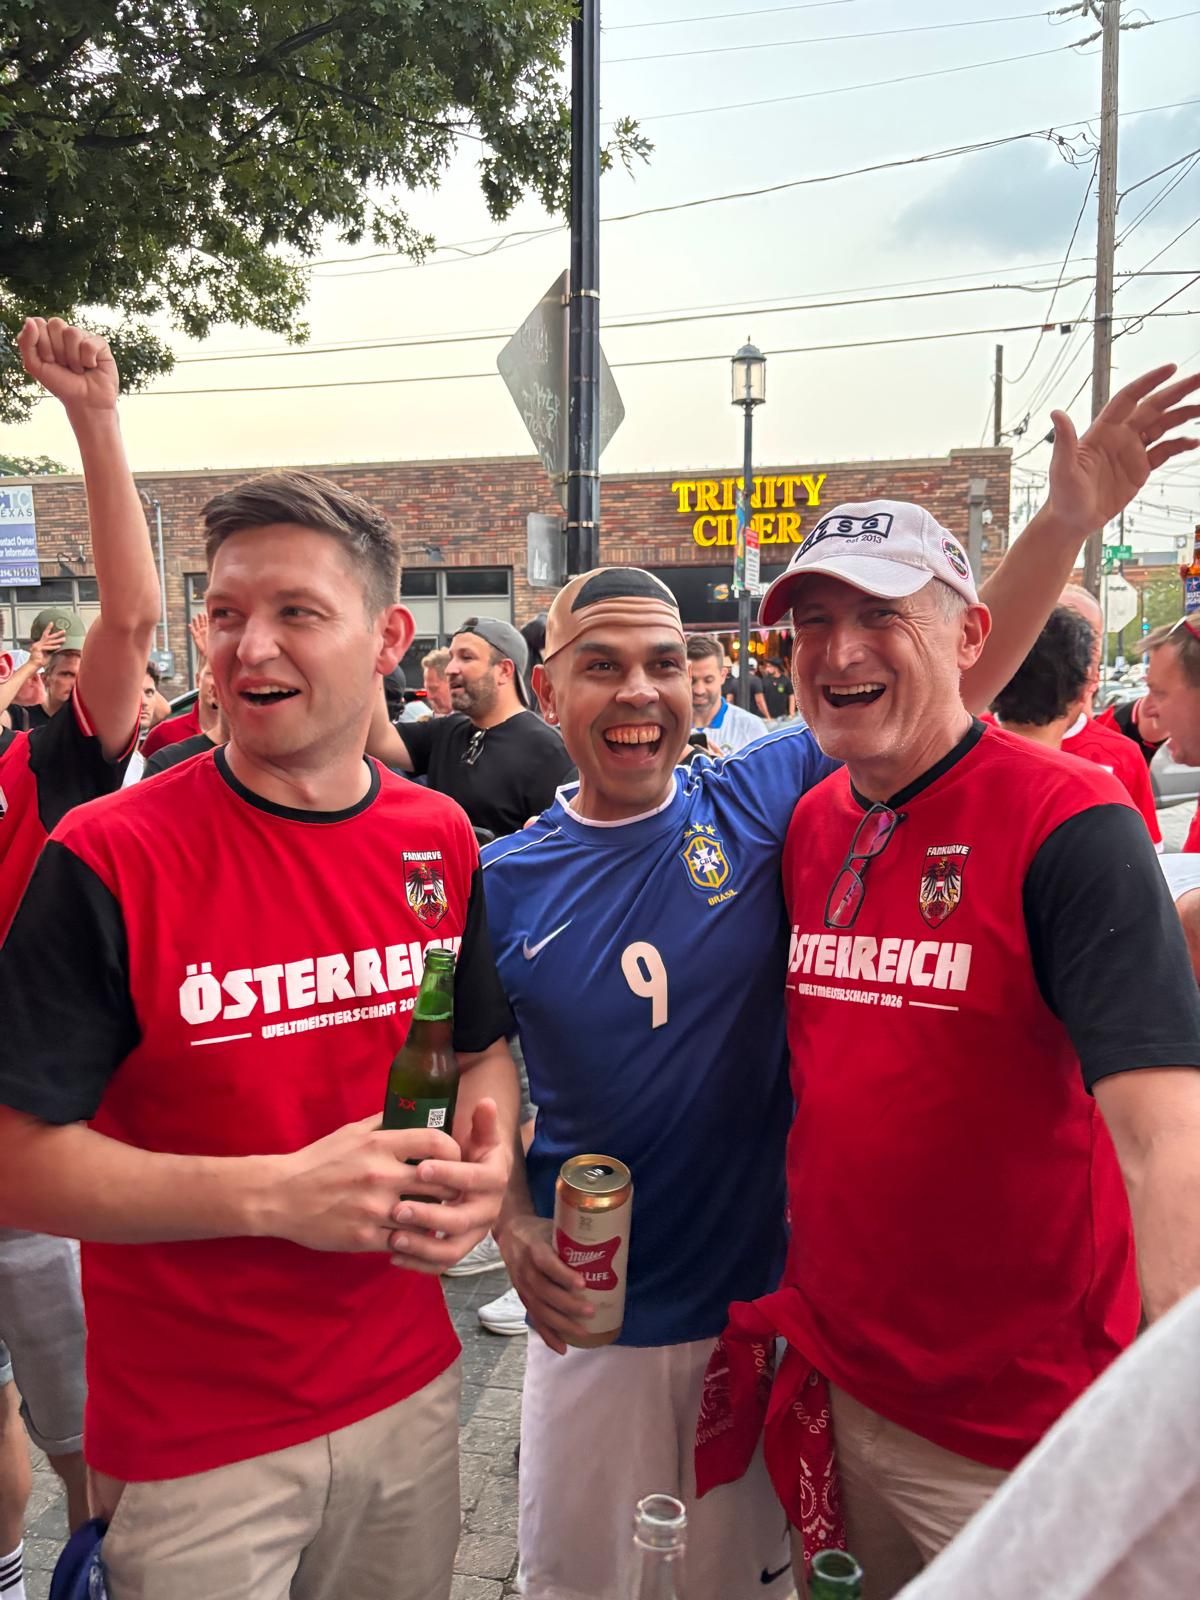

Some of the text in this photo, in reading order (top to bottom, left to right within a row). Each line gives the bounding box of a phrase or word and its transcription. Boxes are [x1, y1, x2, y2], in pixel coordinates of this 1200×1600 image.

[0, 508, 33, 518] EXAS
[0, 536, 35, 547] ontact Owner
[861, 534, 882, 544] 2013
[402, 851, 443, 862] FANKURVE
[926, 844, 970, 857] FANKURVE
[707, 889, 738, 907] BRASIL
[179, 936, 462, 1025] ÖSTERREI
[621, 941, 668, 1029] 9
[798, 983, 904, 1009] WELTMEISTERSCHAFT 2026
[262, 997, 418, 1039] WELTMEISTERSCHAFT 20
[564, 1247, 607, 1267] Miller
[585, 1271, 610, 1282] LIFE
